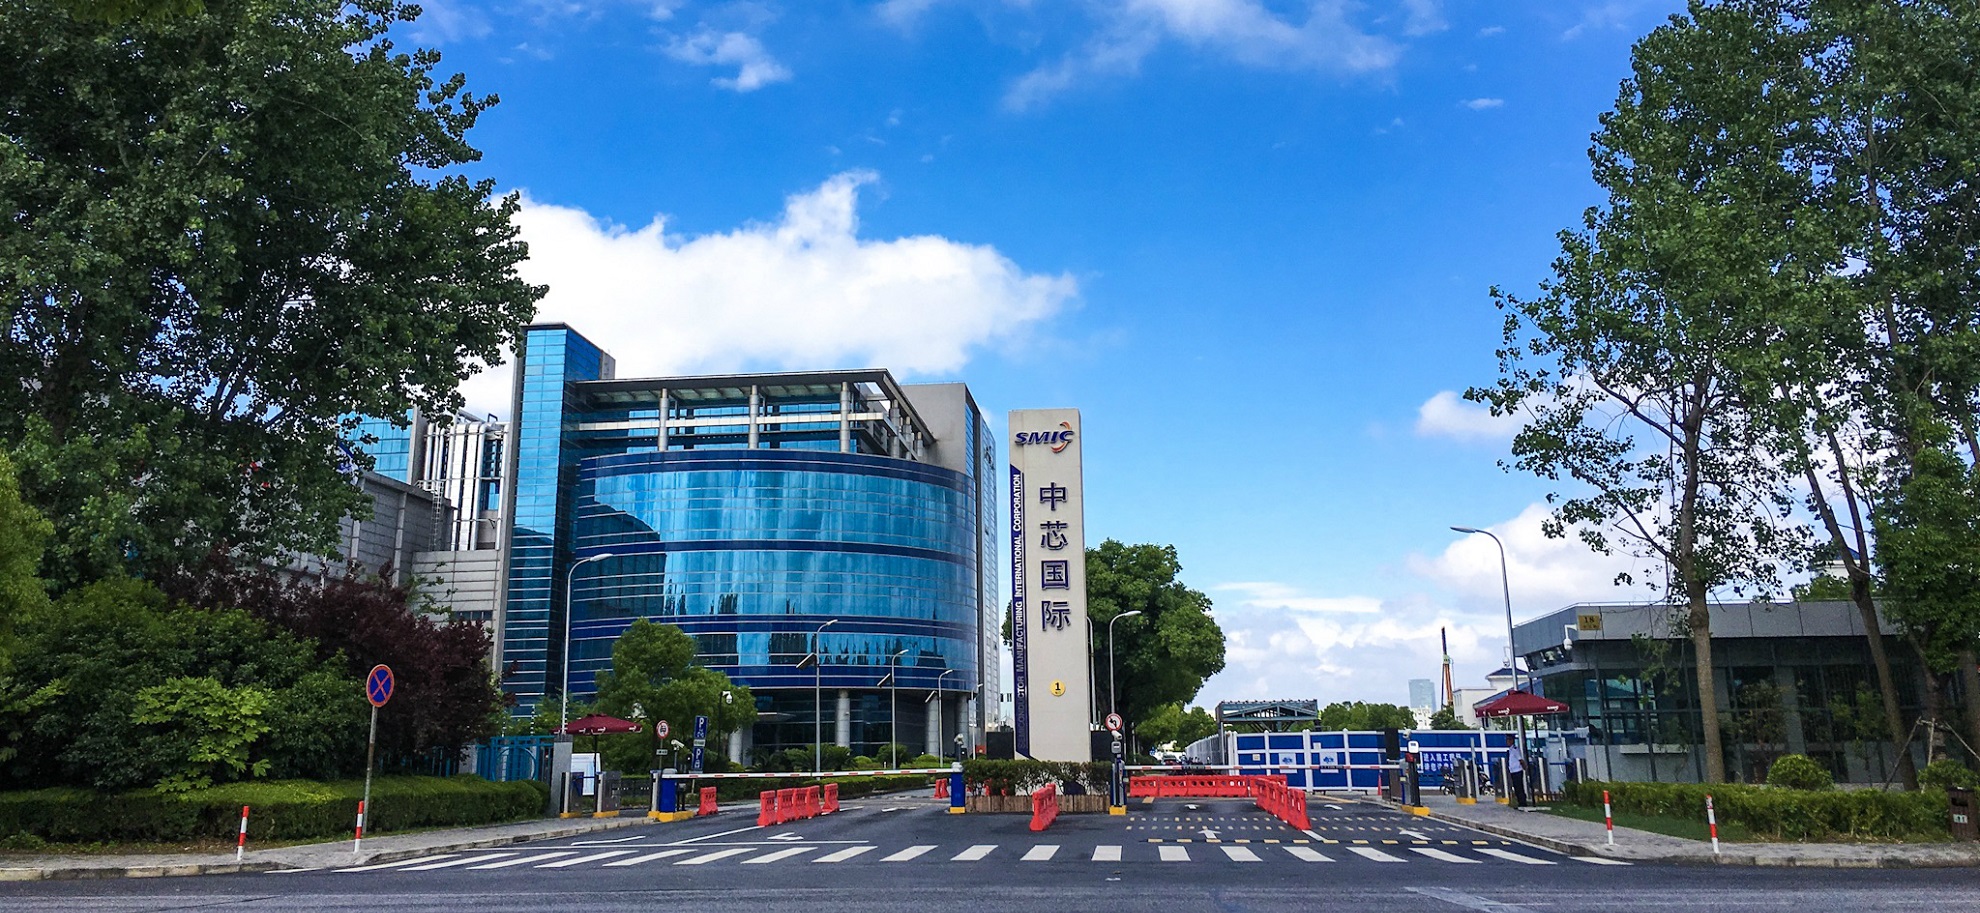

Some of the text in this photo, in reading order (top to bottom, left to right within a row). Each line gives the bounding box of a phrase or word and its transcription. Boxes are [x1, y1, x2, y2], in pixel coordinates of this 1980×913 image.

[1015, 430, 1074, 444] SMIC
[1040, 482, 1071, 631] 中芯国际
[1013, 474, 1025, 749] SEMICONDUCTOR MANUFACTURING INTERNATIONAL CORPORATION
[1584, 616, 1595, 624] 18
[1055, 682, 1061, 690] 1
[699, 717, 705, 728] P
[695, 748, 702, 760] P
